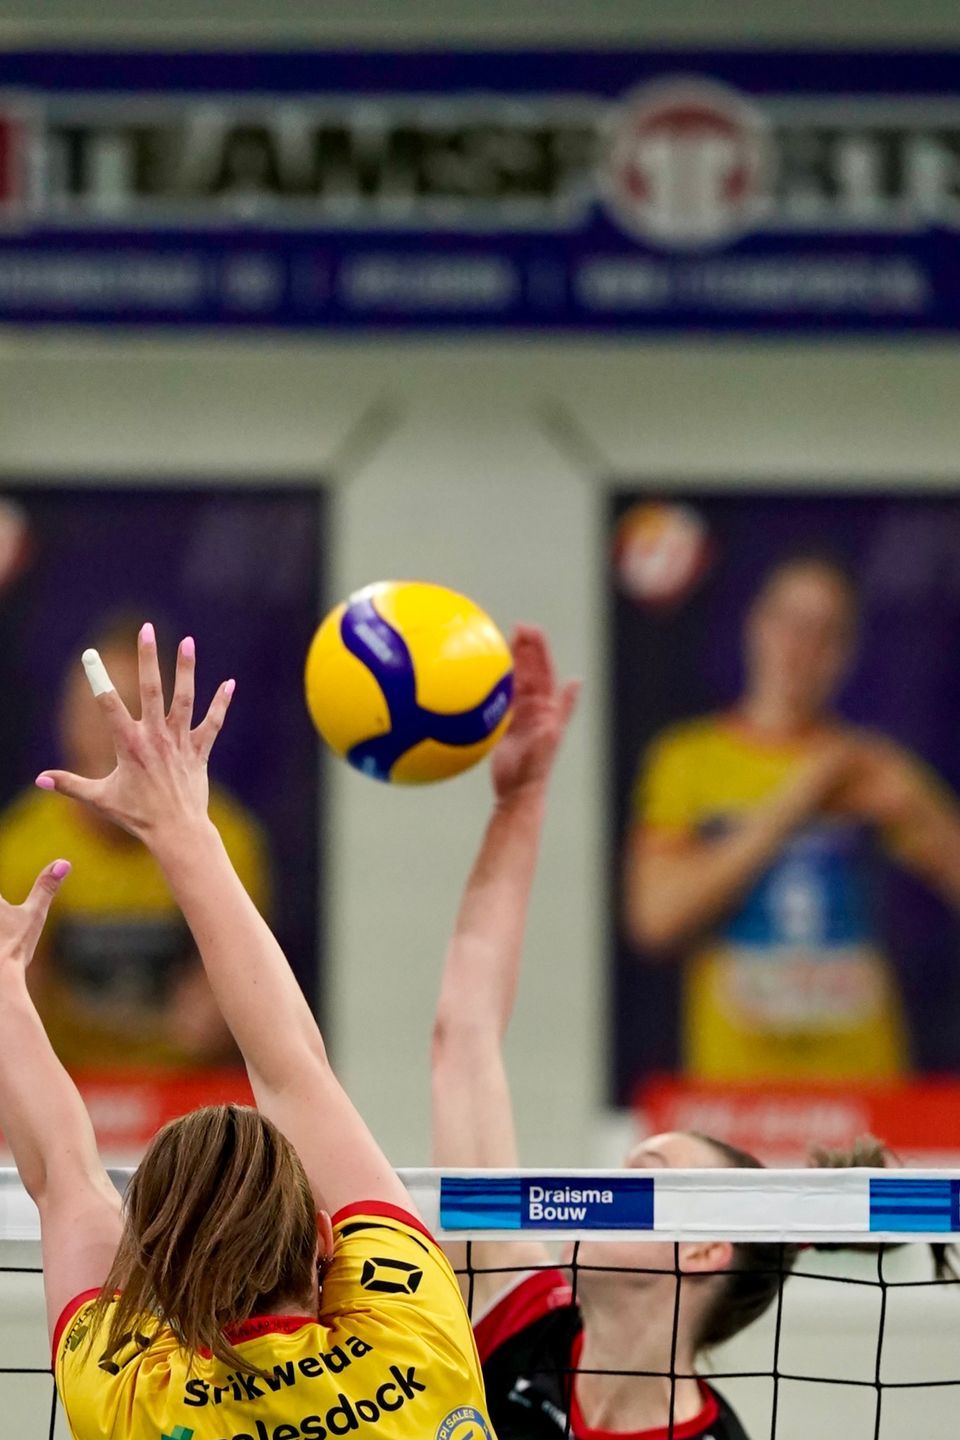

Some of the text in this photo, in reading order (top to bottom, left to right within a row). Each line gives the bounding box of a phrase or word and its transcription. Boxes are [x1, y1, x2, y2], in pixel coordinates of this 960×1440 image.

[529, 1186, 613, 1204] Draisma
[529, 1203, 587, 1220] Bouw
[445, 1408, 475, 1428] SALES
